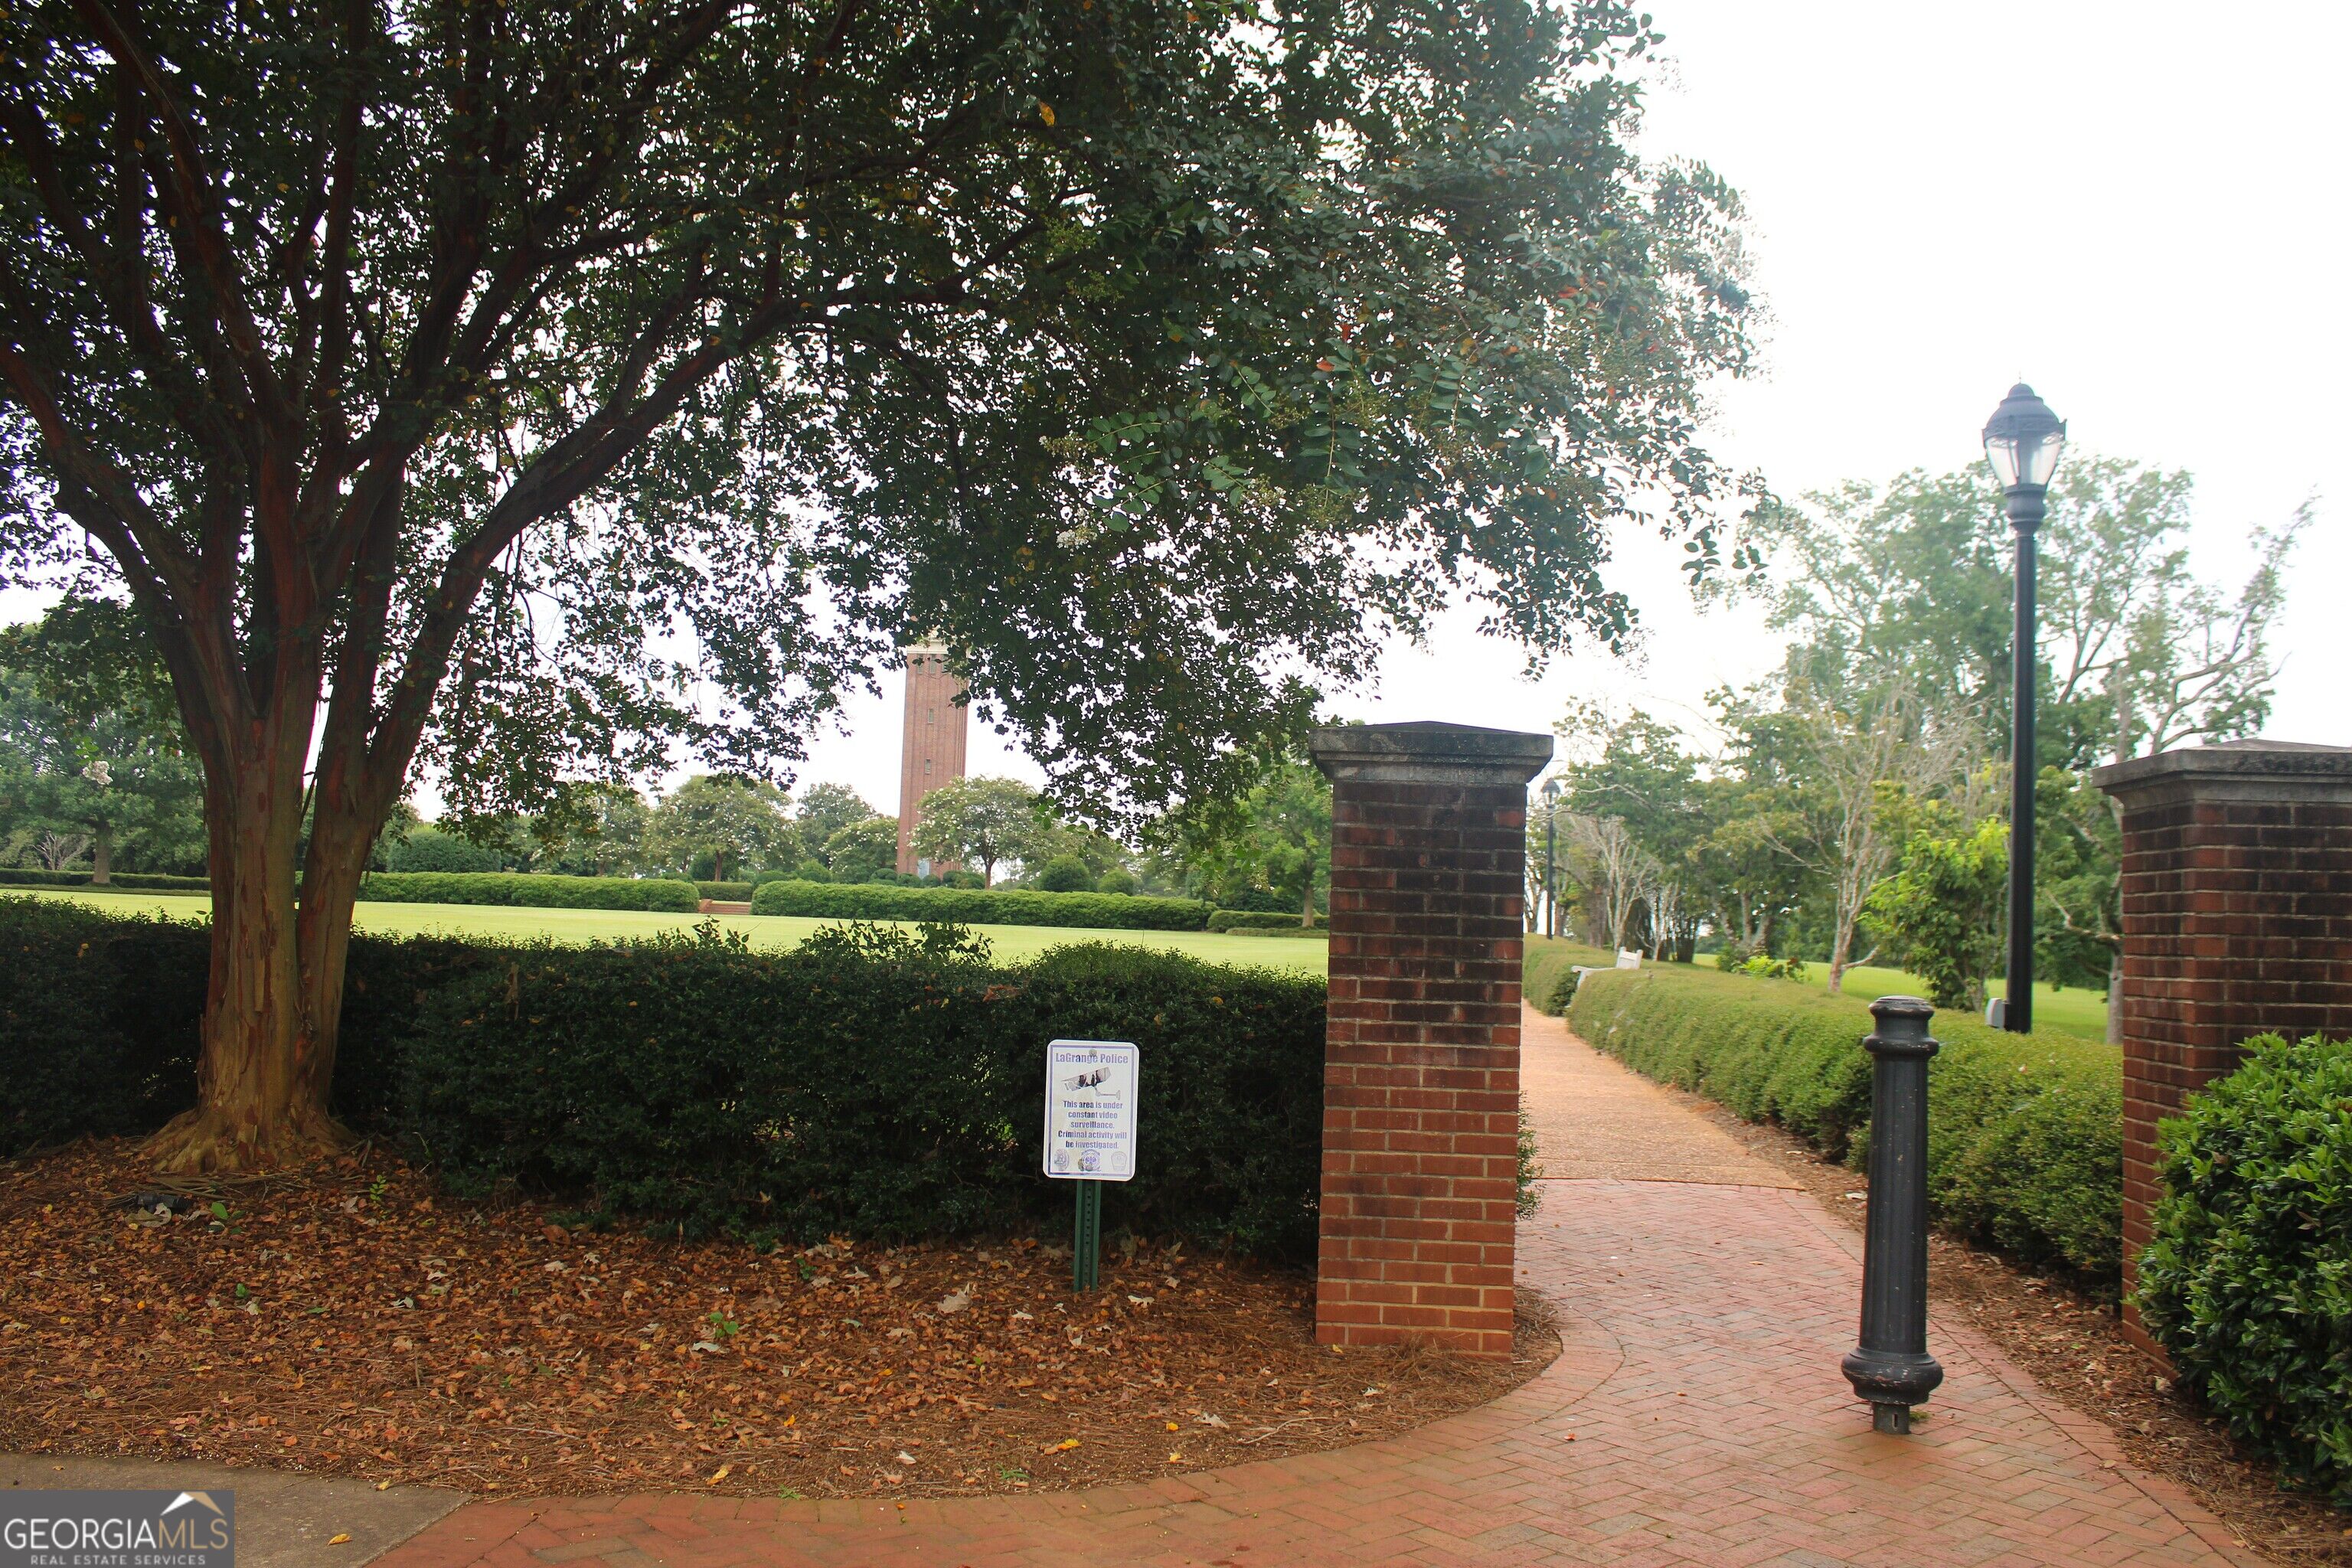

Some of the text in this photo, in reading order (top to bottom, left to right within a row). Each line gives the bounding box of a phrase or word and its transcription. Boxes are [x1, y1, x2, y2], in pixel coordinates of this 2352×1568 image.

[1056, 1053, 1129, 1064] LaGrange Police
[1096, 1100, 1102, 1109] is
[1103, 1101, 1123, 1109] under
[1070, 1121, 1115, 1129] surveillance.
[1058, 1130, 1087, 1138] Criminal
[1088, 1131, 1114, 1140] activity
[1075, 1141, 1119, 1149] investigated.
